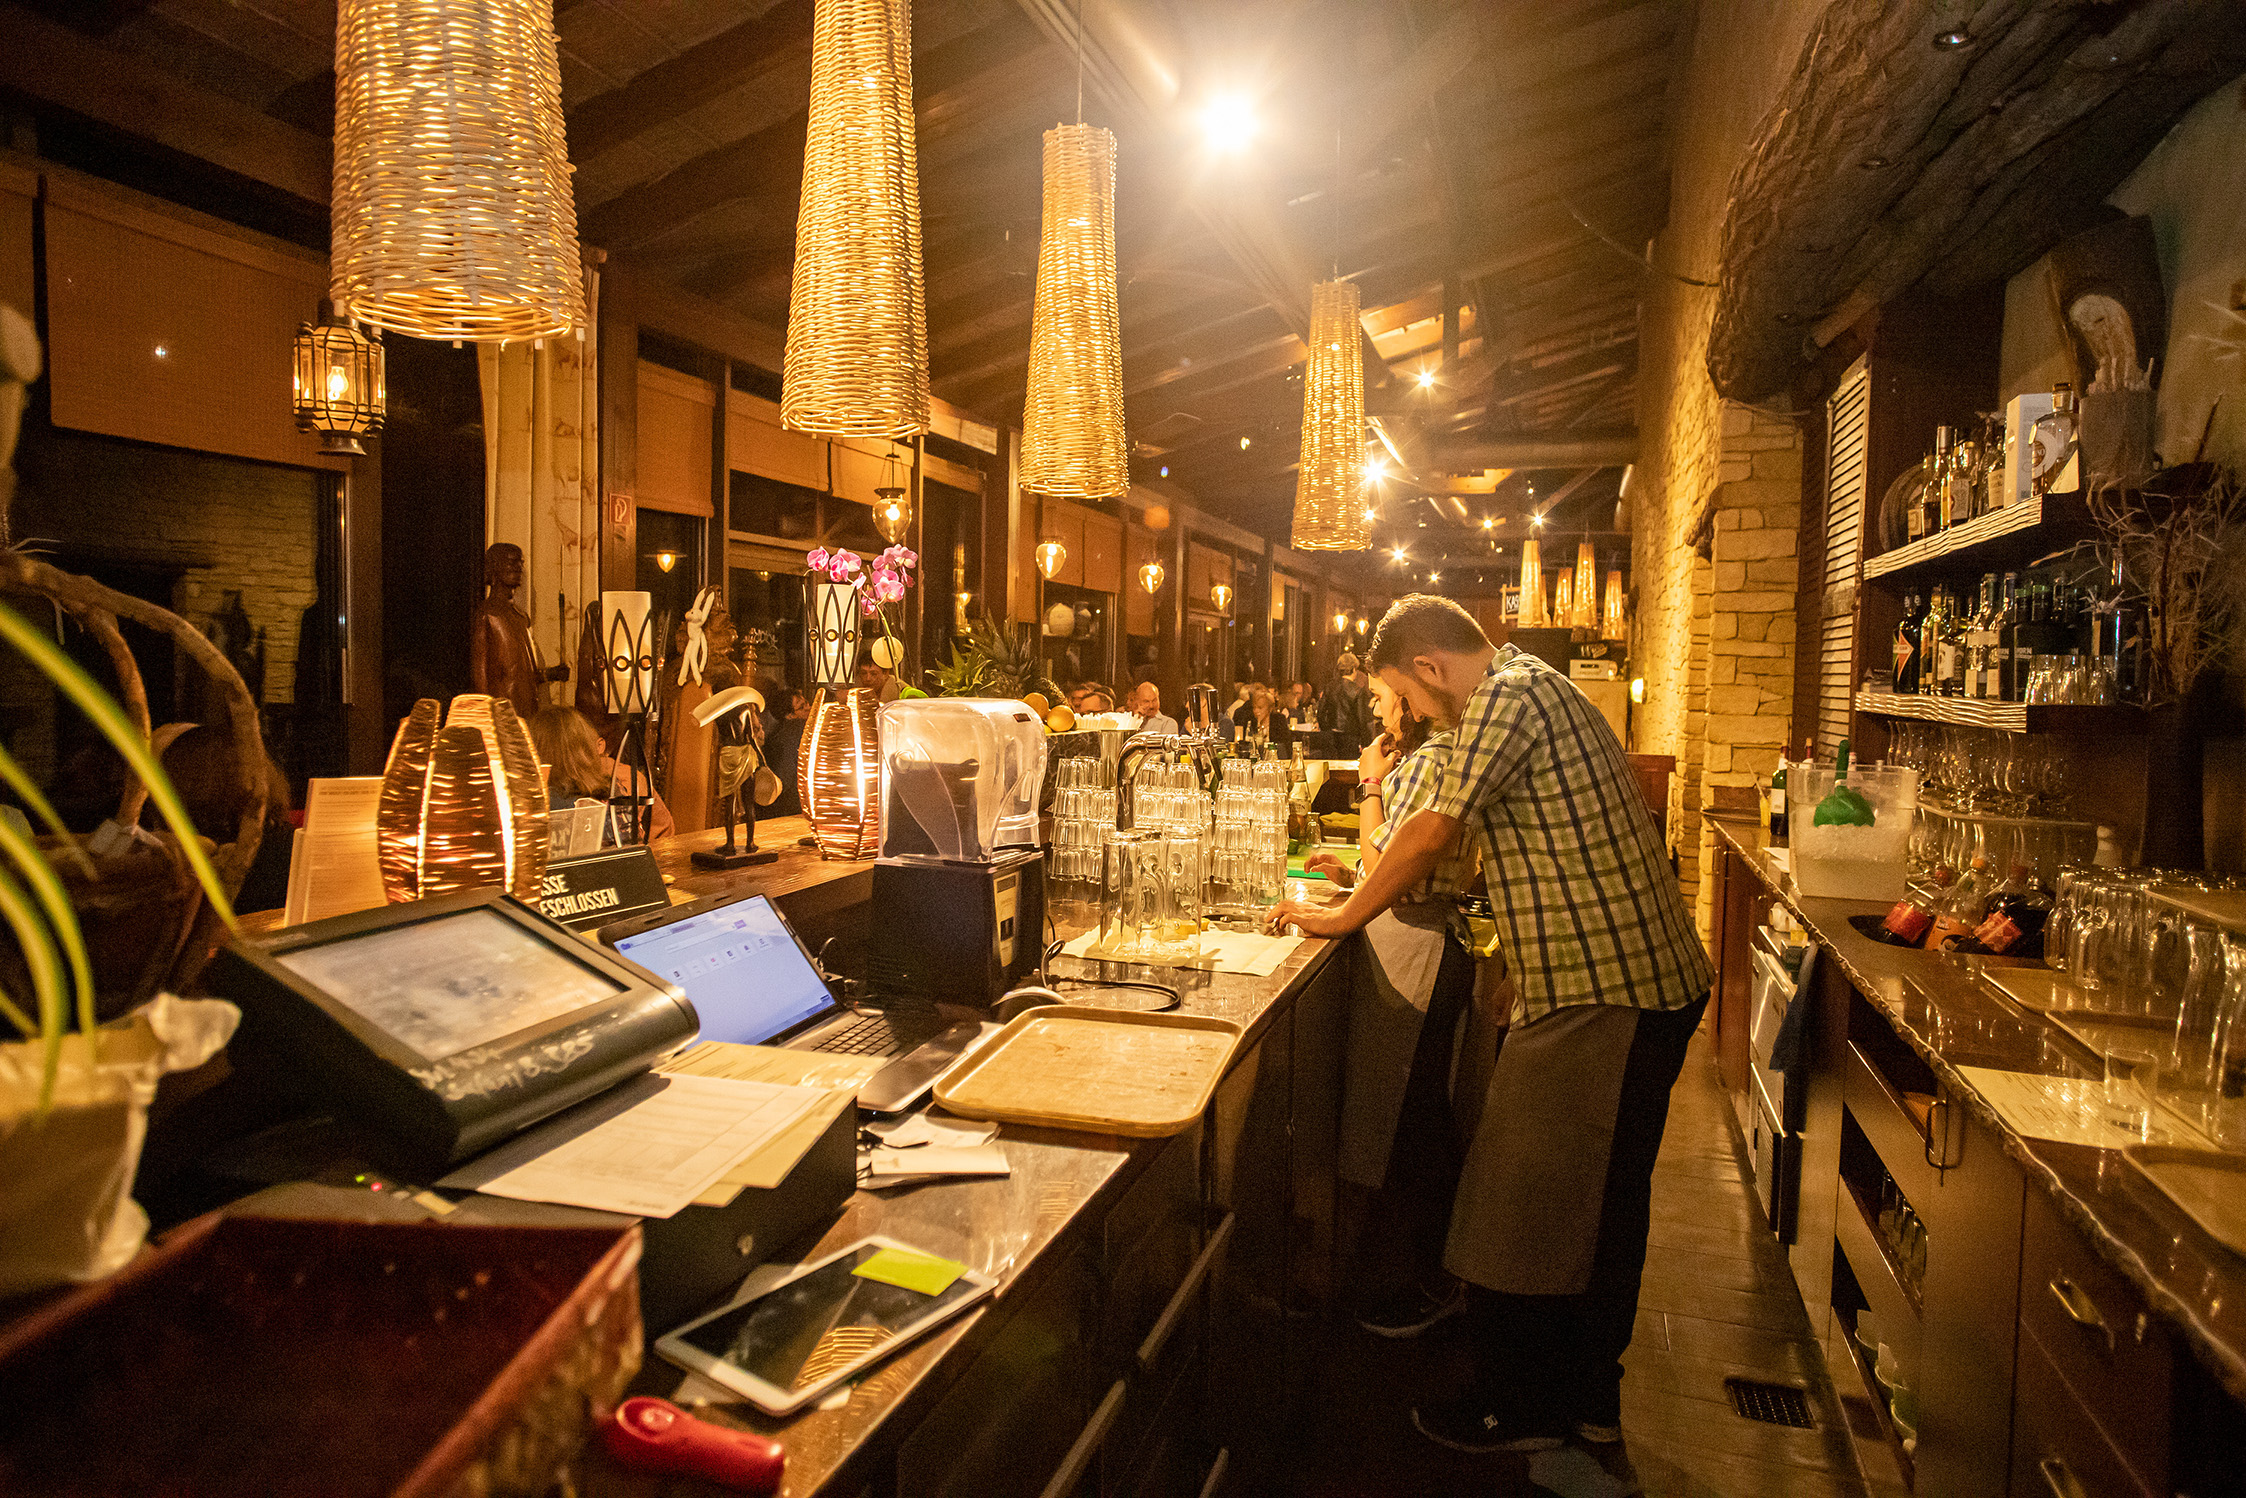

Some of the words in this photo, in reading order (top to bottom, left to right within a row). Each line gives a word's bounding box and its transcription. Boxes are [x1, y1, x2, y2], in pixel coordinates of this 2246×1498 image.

[1506, 594, 1519, 611] KAS
[541, 873, 570, 897] SSE
[540, 887, 620, 918] ESCHLOSSEN
